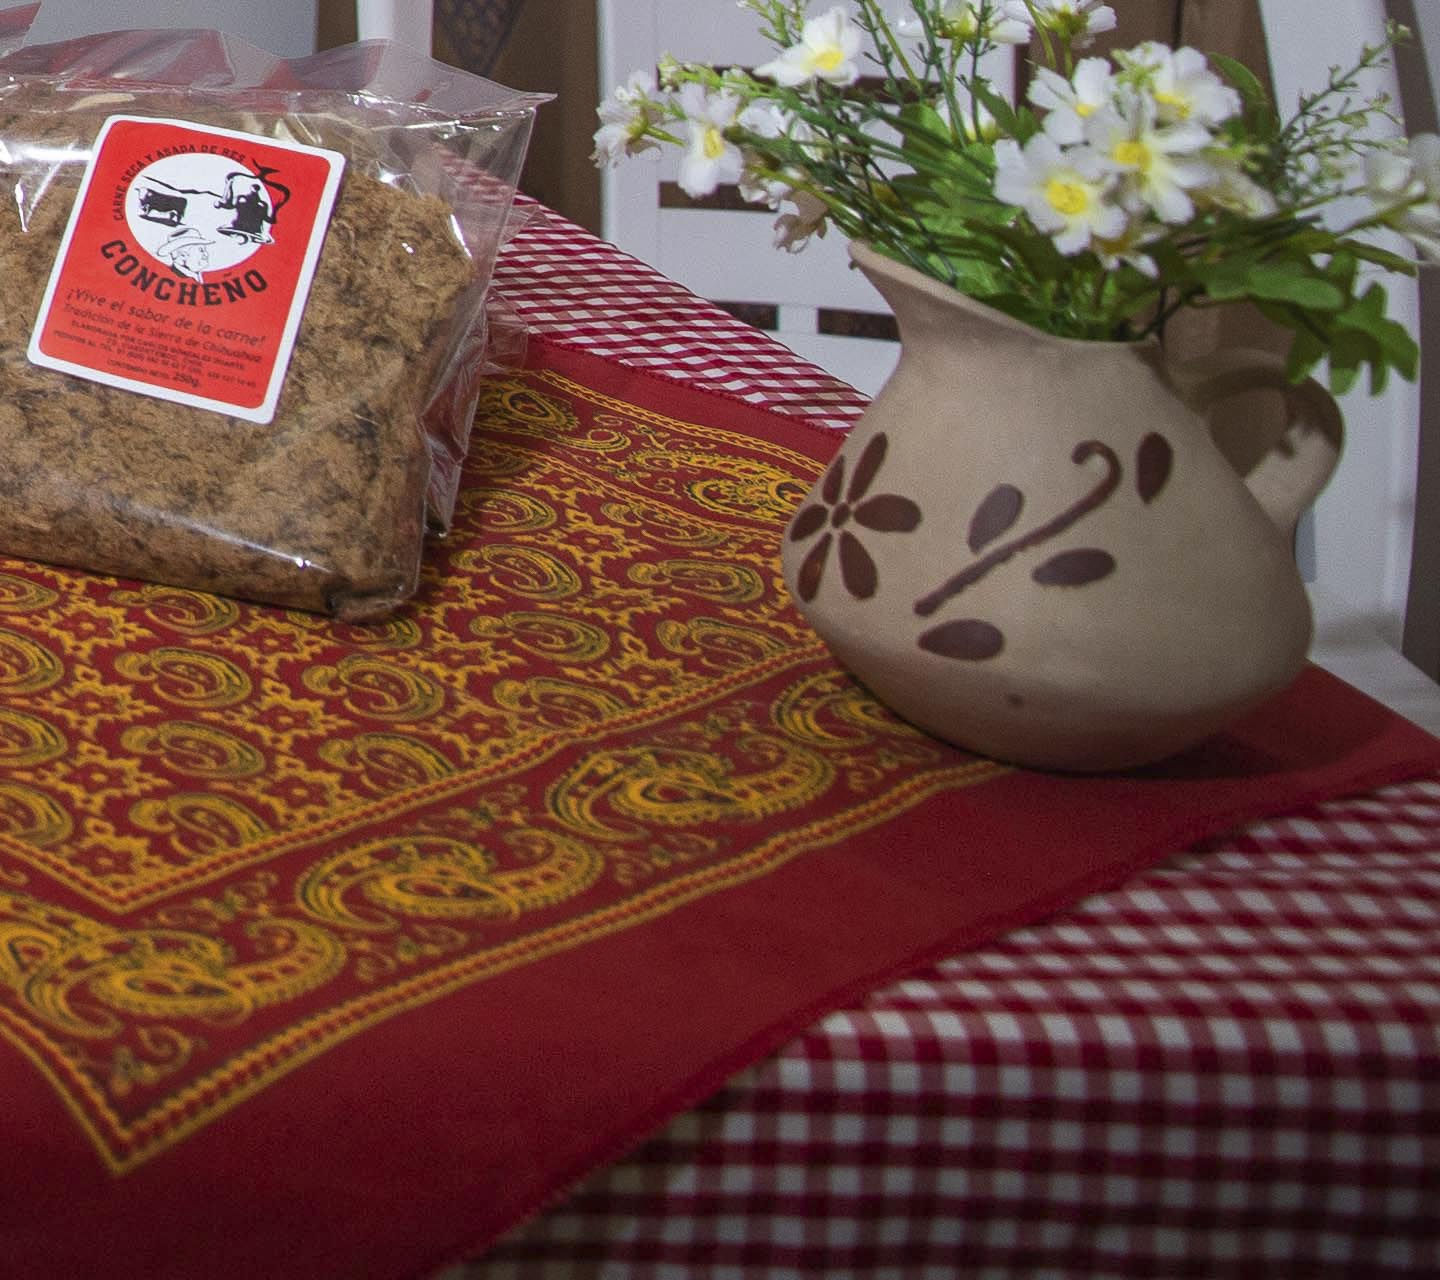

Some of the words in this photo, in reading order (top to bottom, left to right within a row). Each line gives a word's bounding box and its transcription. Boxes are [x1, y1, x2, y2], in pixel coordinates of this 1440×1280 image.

[113, 185, 126, 220] CARNE
[121, 160, 145, 182] SECA
[145, 152, 154, 162] Y
[156, 144, 196, 160] ASADA
[201, 144, 218, 153] DE
[222, 148, 246, 162] RES
[101, 239, 268, 307] CONCHEÑO
[111, 300, 124, 312] el
[128, 304, 170, 324] sabor
[175, 314, 193, 329] de
[197, 319, 212, 335] la
[216, 326, 265, 347] carne!
